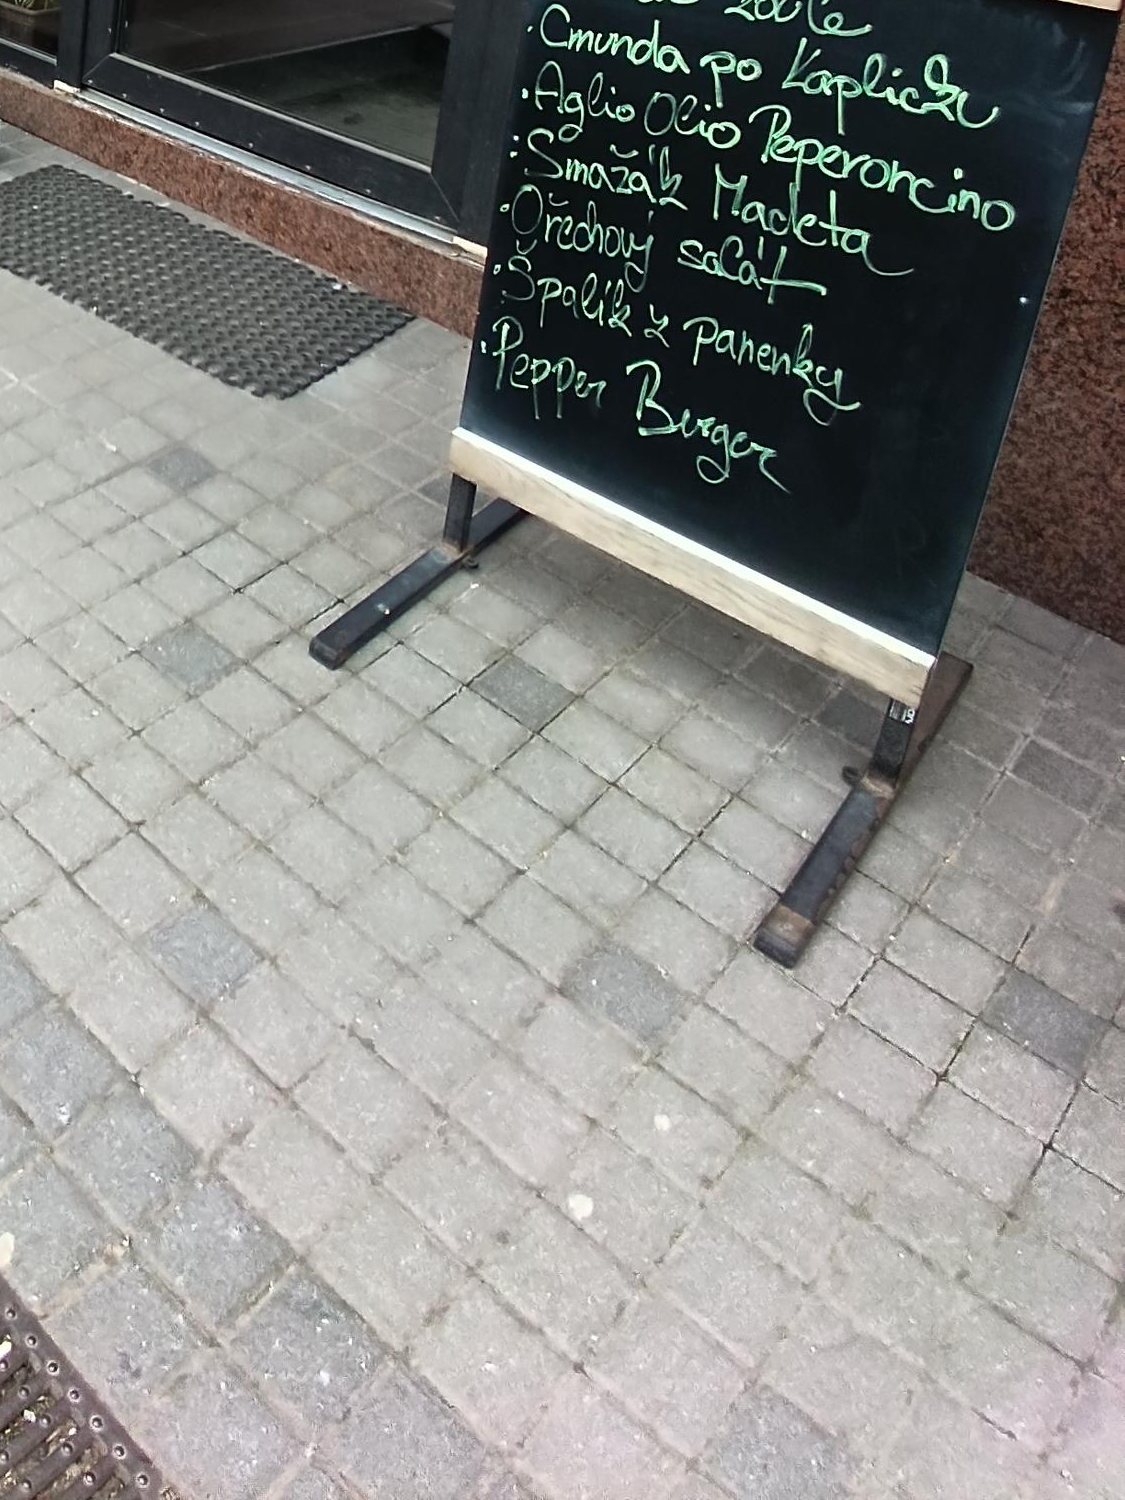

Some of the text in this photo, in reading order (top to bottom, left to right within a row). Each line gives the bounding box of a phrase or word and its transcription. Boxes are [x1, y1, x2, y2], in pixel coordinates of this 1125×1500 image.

[540, 4, 690, 74] Cmunda
[700, 51, 762, 109] po
[524, 127, 914, 276] Smažák Madeta
[535, 60, 1016, 231] Aglio Olio Peperoncino
[512, 184, 827, 304] Ořechový salát
[492, 315, 791, 494] Pepper Burger
